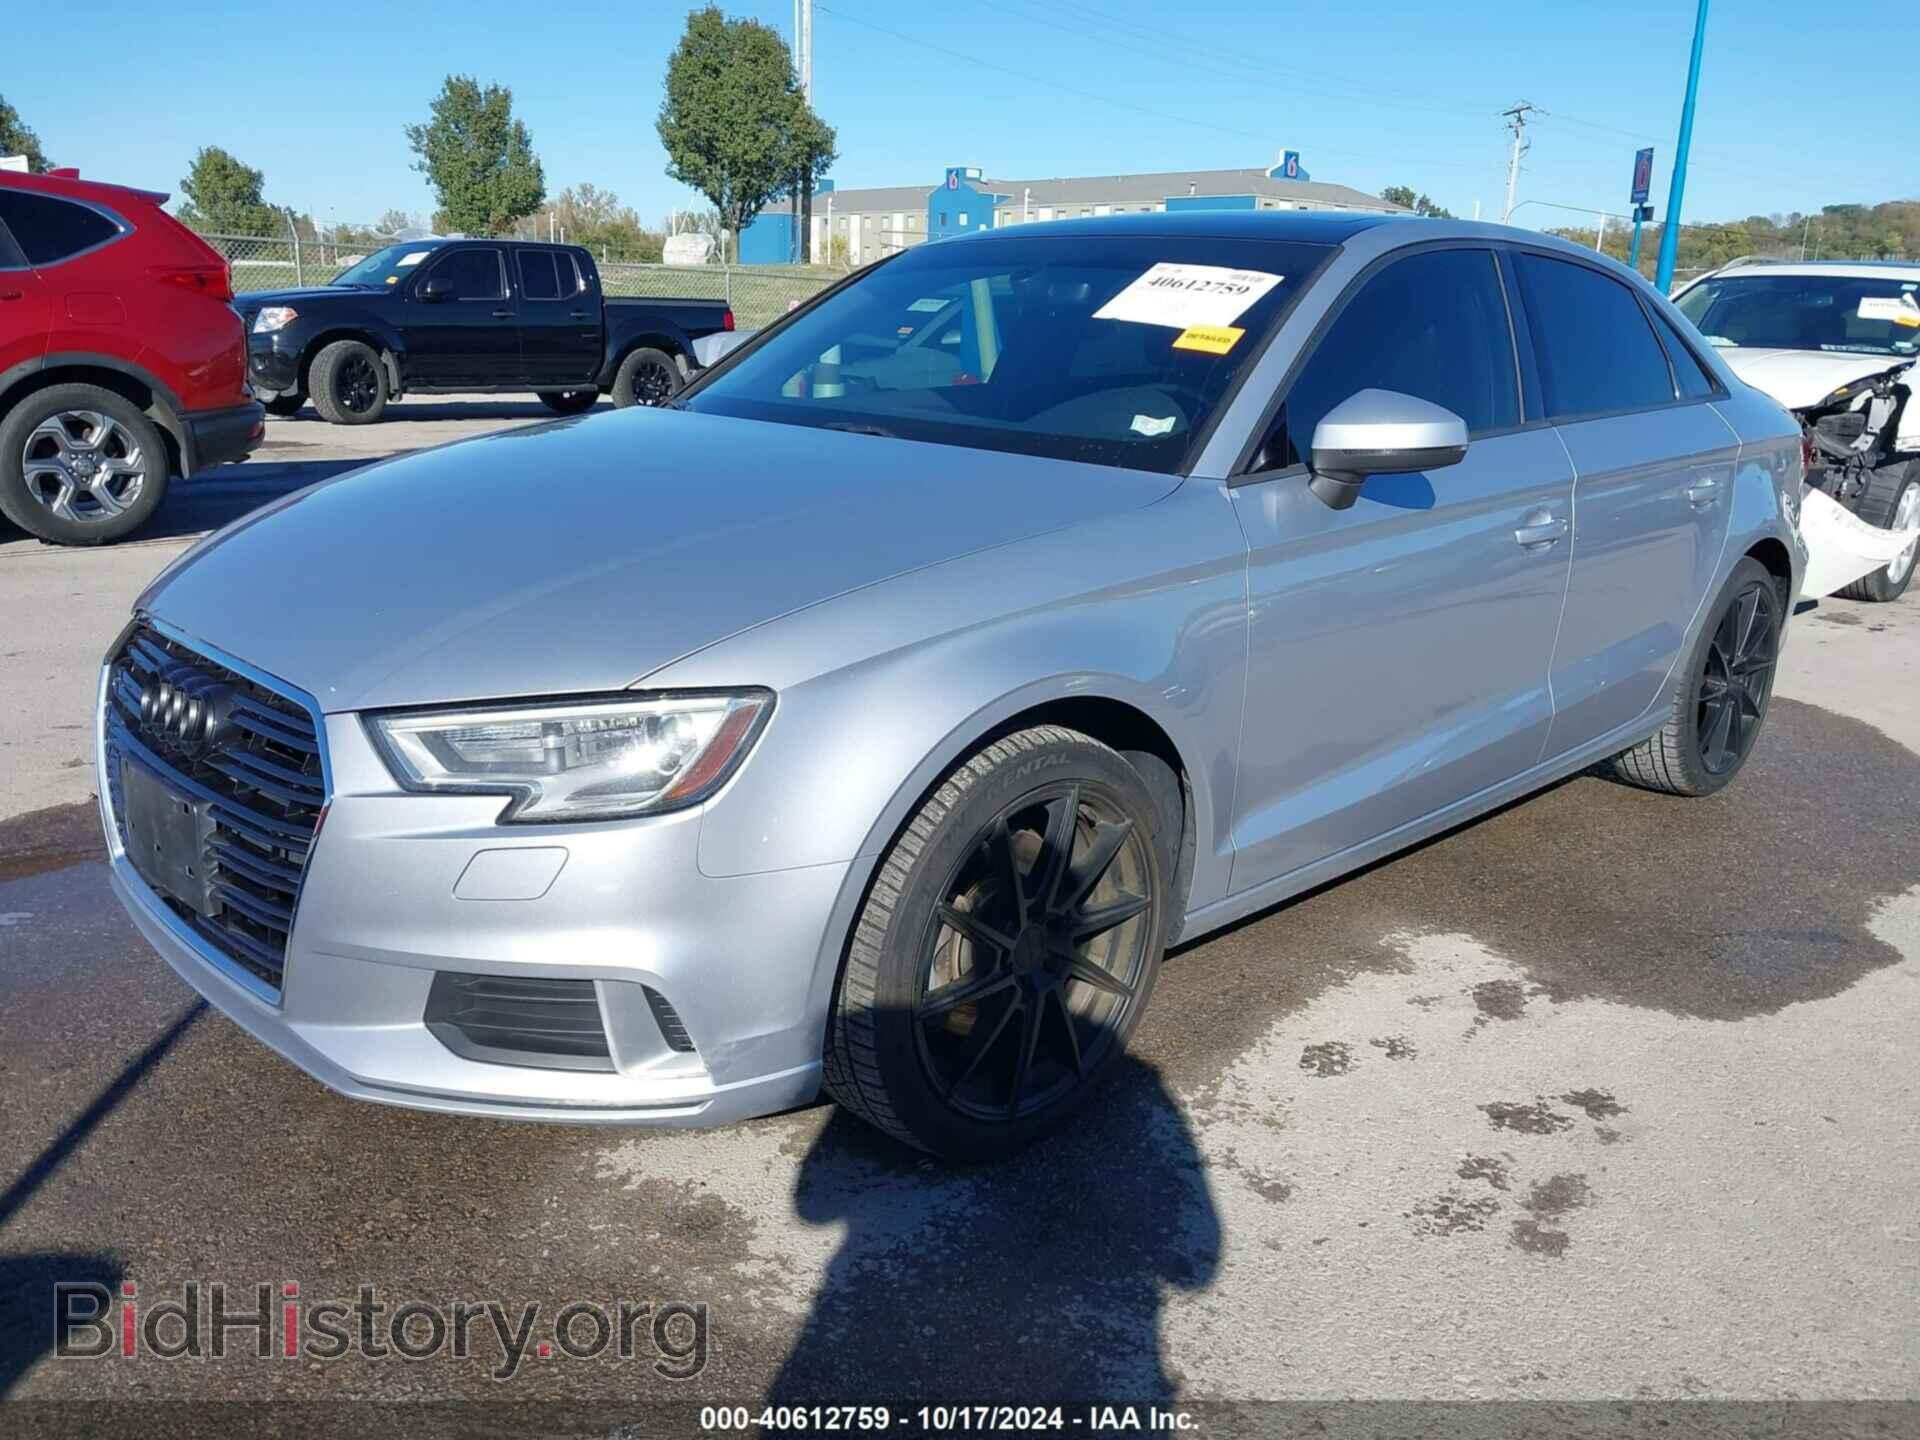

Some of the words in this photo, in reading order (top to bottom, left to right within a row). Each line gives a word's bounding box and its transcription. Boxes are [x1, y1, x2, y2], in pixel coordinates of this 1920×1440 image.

[1287, 155, 1297, 177] 6
[949, 170, 958, 190] 6
[1148, 276, 1250, 295] 40612759
